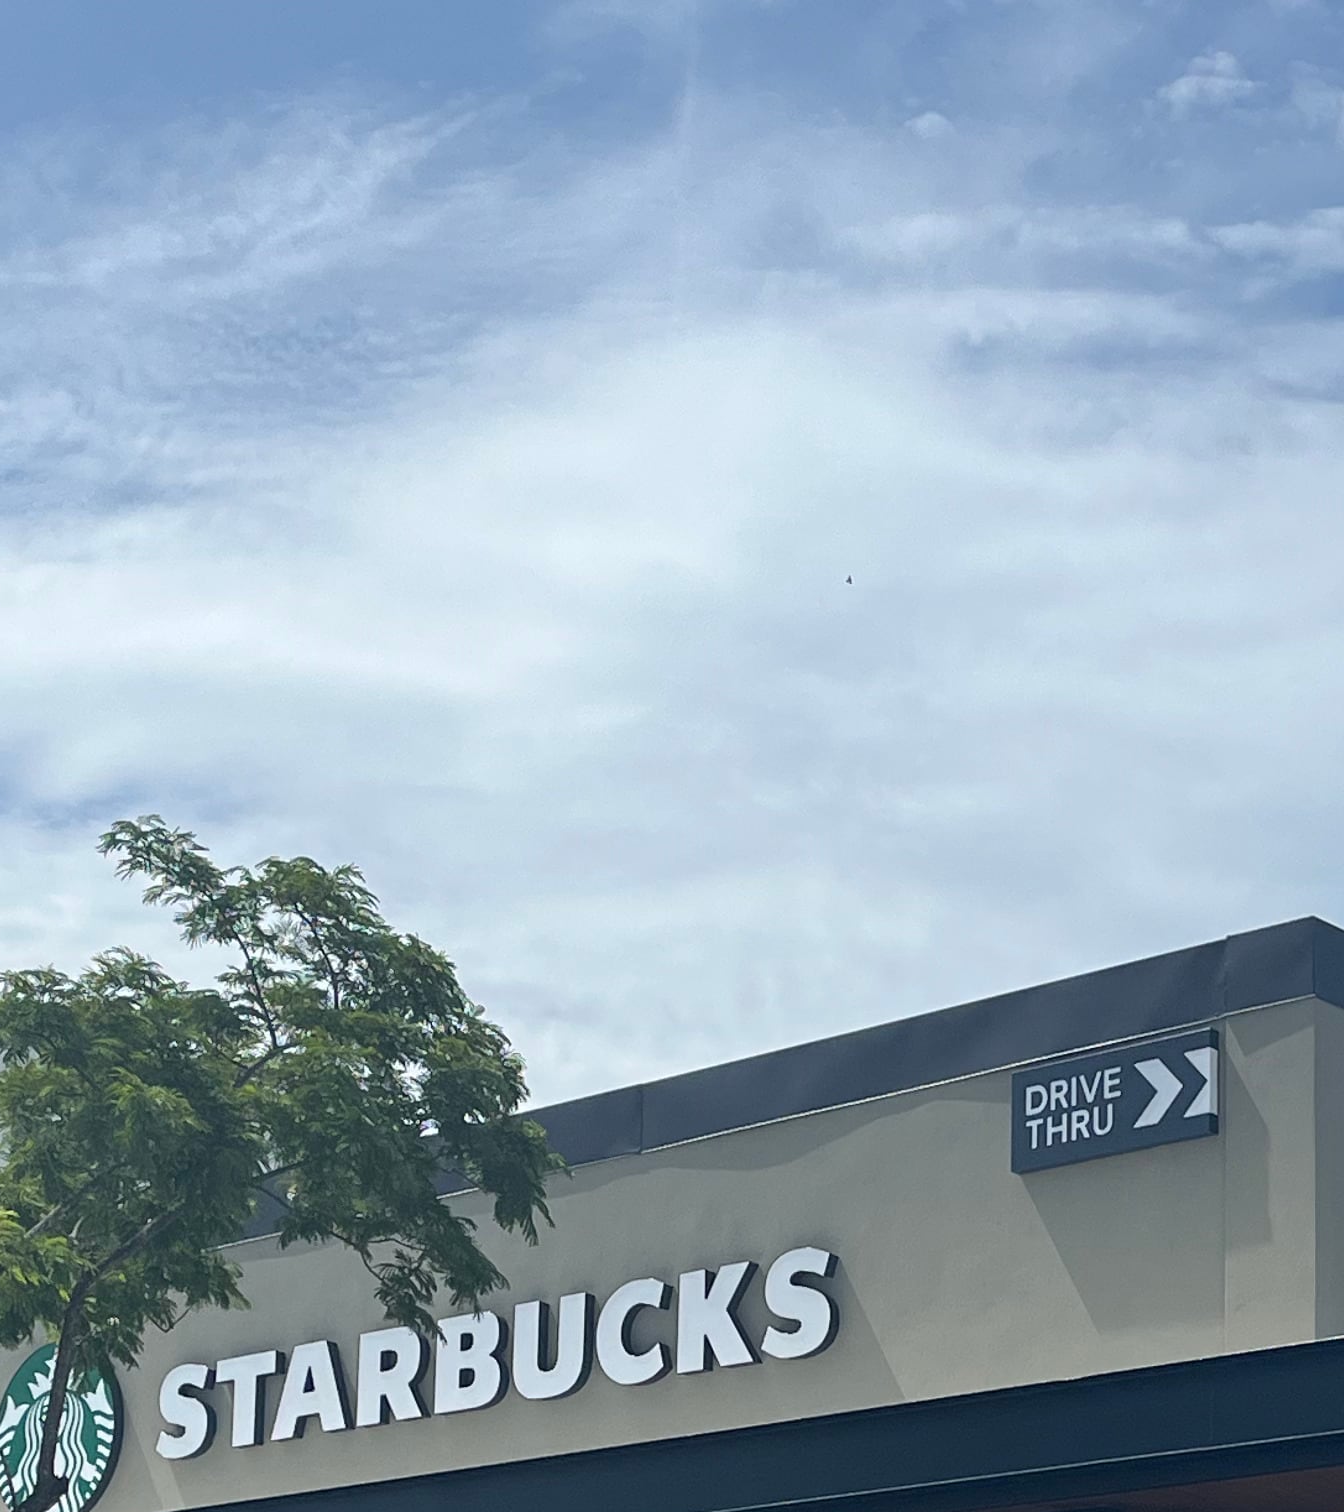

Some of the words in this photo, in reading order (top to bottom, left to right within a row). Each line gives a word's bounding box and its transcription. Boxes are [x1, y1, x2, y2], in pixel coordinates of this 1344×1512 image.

[1025, 1066, 1122, 1117] DRIVE
[1025, 1103, 1113, 1149] THRU
[156, 1246, 840, 1460] STARBUCKS
